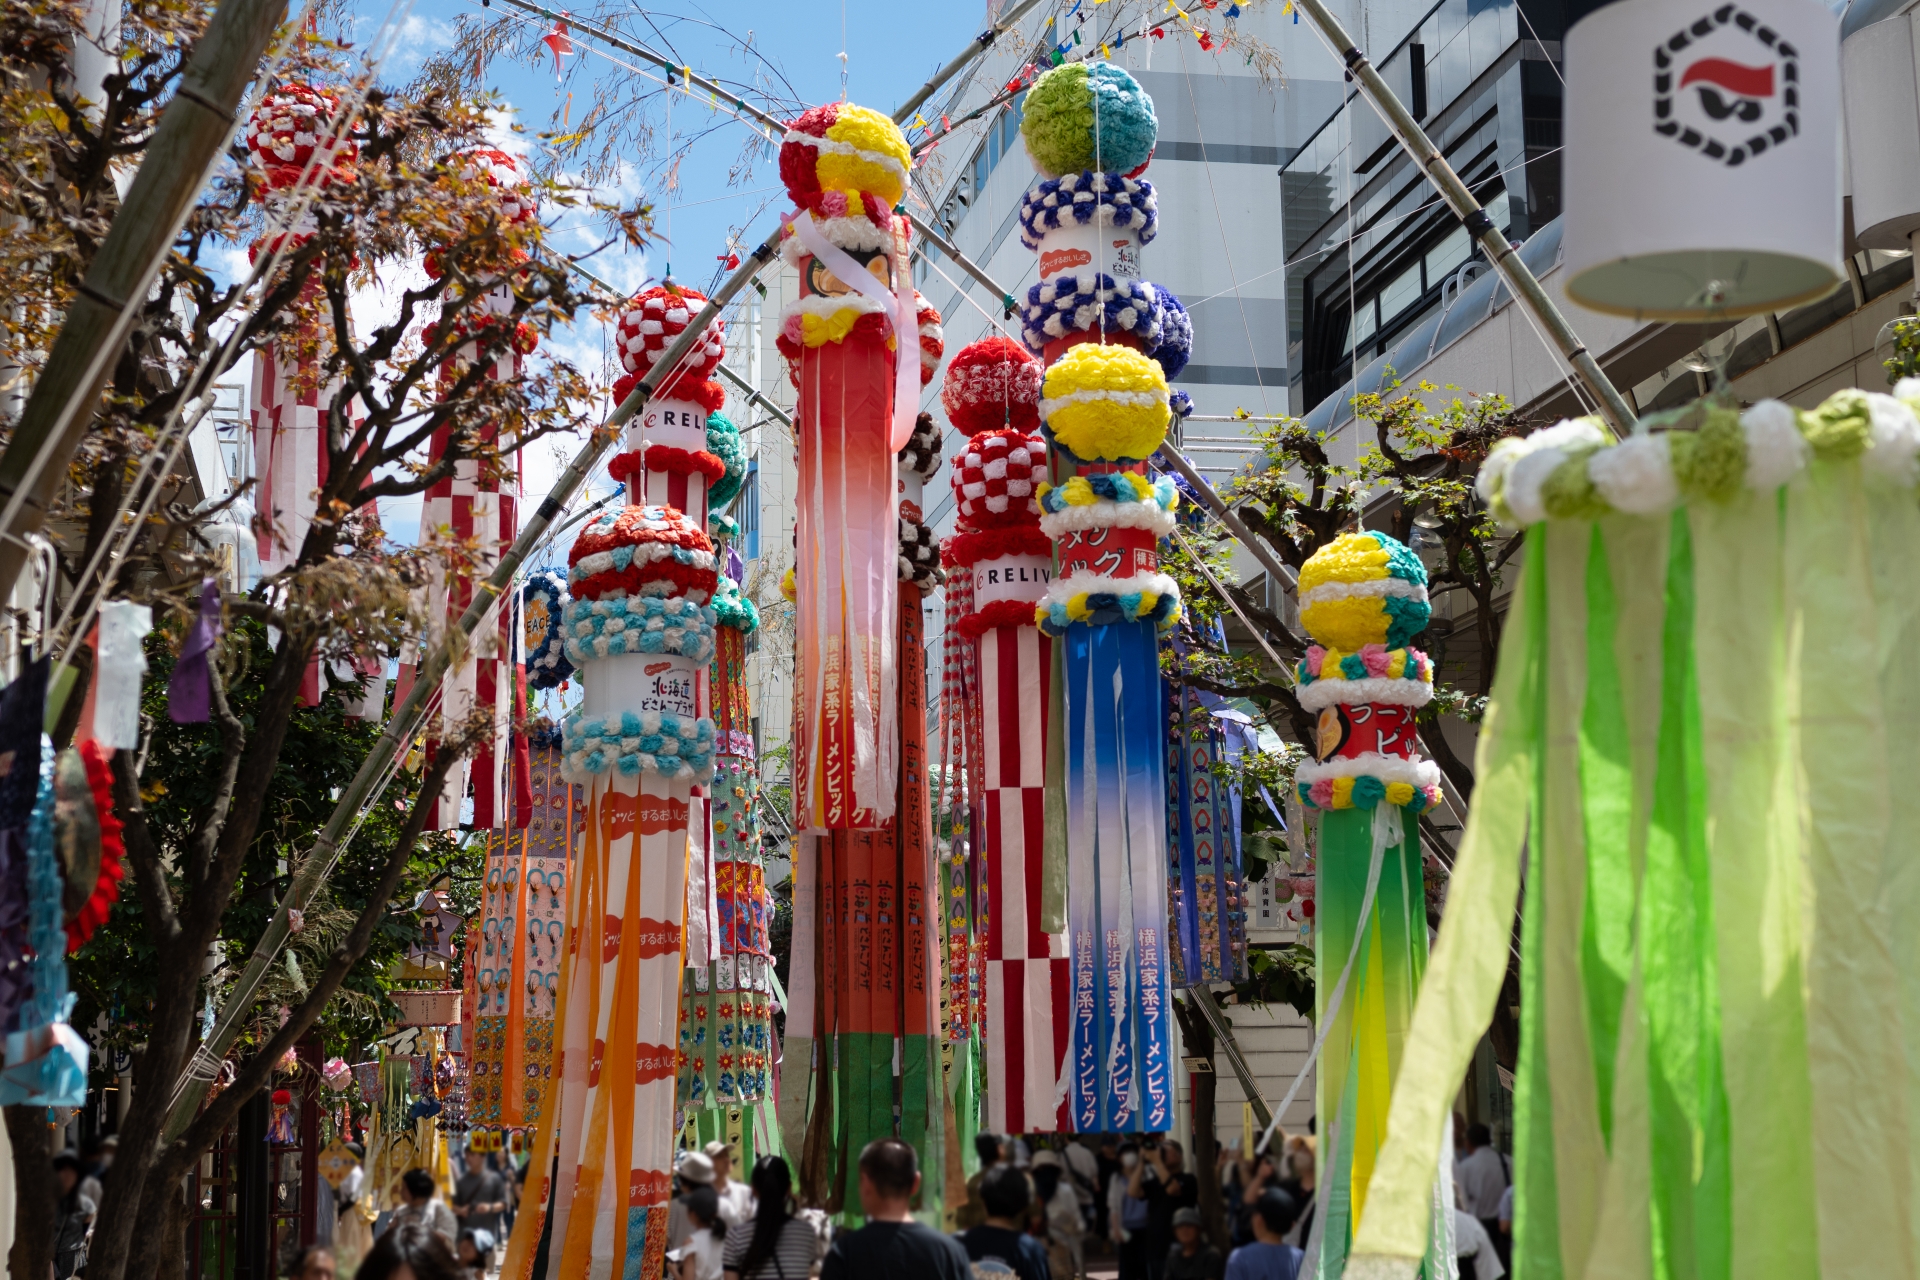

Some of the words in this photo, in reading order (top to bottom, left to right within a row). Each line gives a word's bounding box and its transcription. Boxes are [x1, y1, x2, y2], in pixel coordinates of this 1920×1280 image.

[526, 614, 550, 634] EACE
[652, 676, 690, 700] 北海道
[825, 635, 842, 824] 横浜家系ラーメンビッグ
[1138, 928, 1165, 1127] 横浜家系ラーメンビッグ
